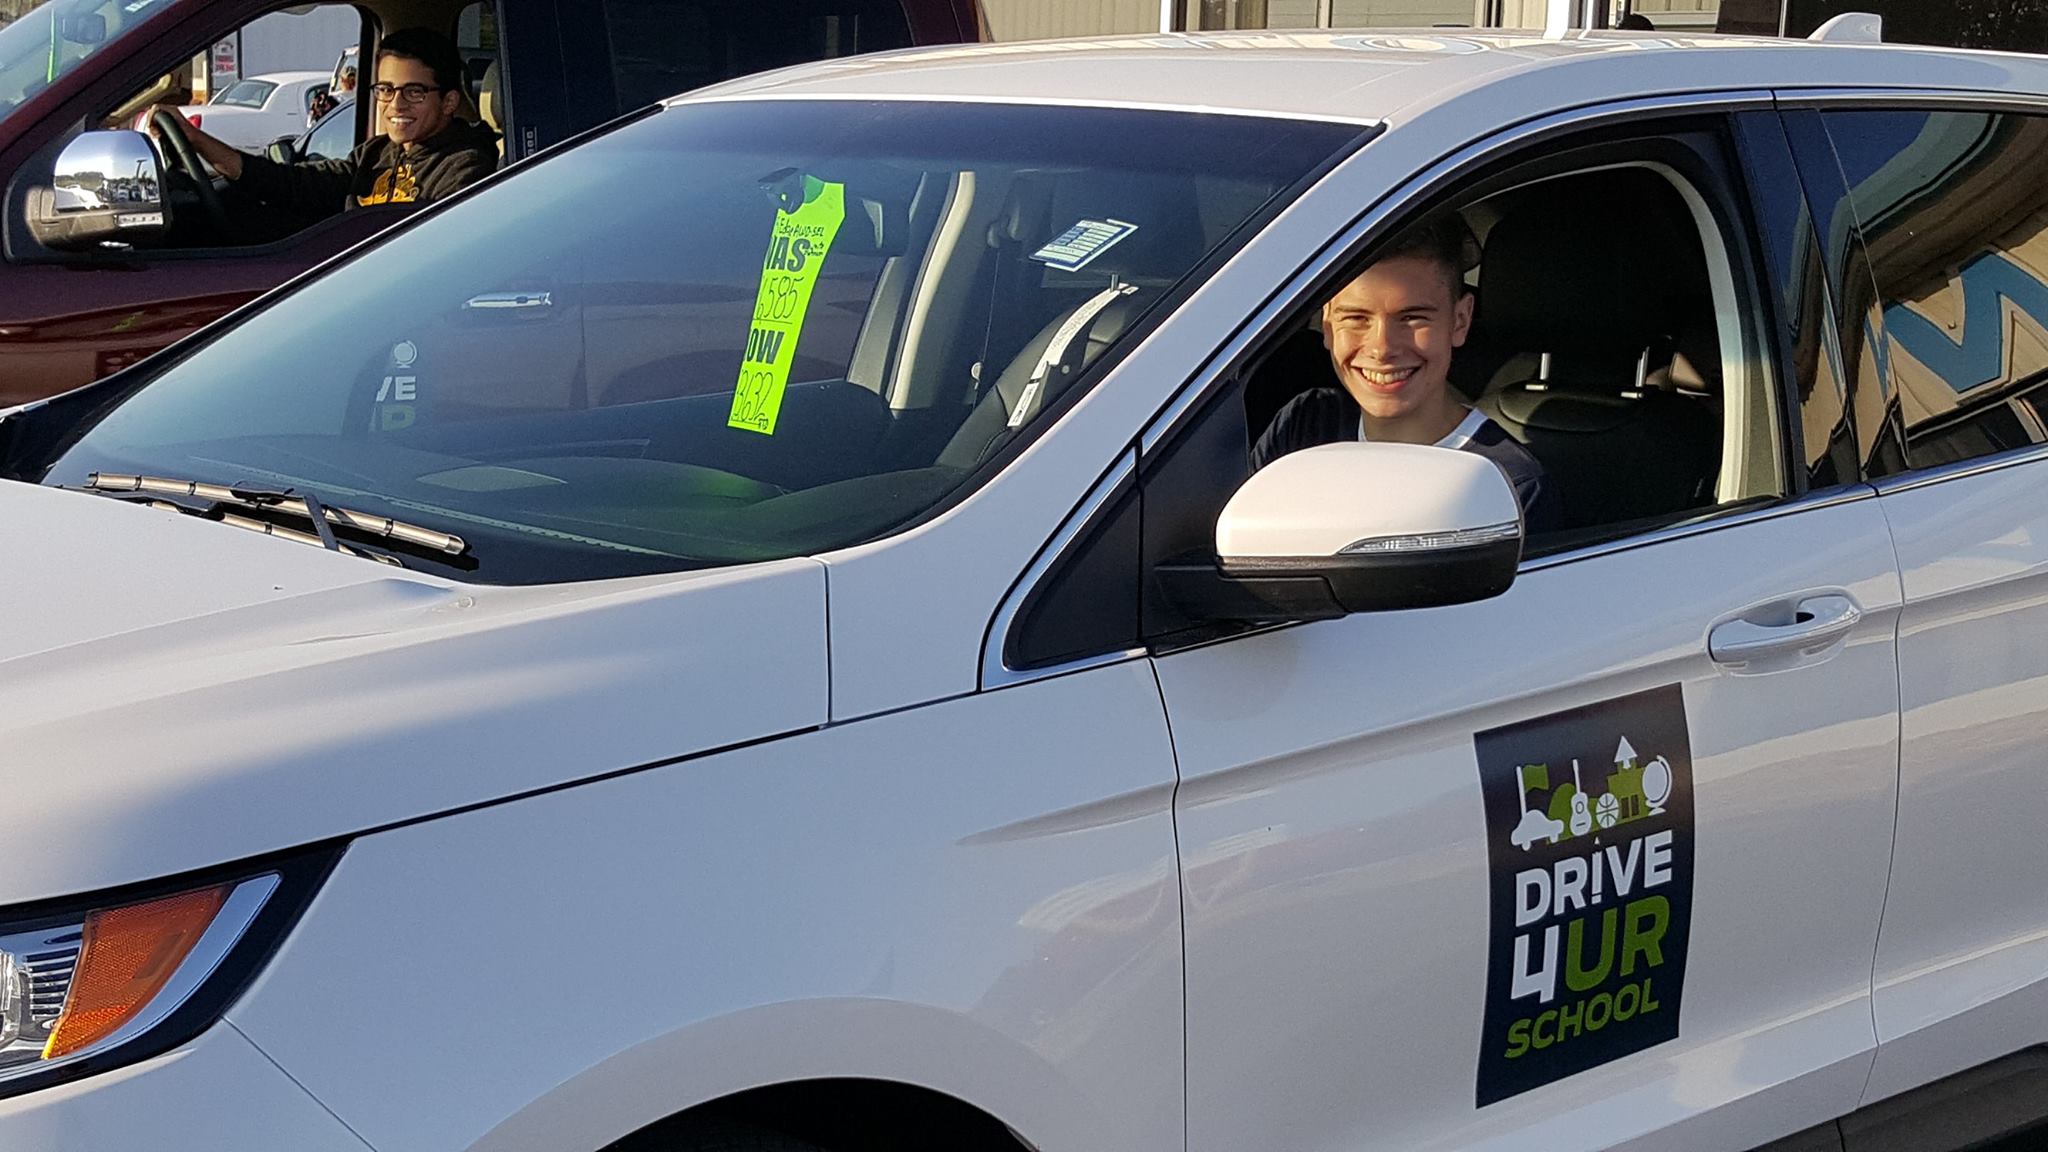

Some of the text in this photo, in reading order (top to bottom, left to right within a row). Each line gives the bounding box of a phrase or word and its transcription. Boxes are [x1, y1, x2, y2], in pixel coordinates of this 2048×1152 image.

[744, 328, 785, 365] OW
[1515, 829, 1673, 928] DRIVE
[1504, 978, 1660, 1059] SCHOOL
